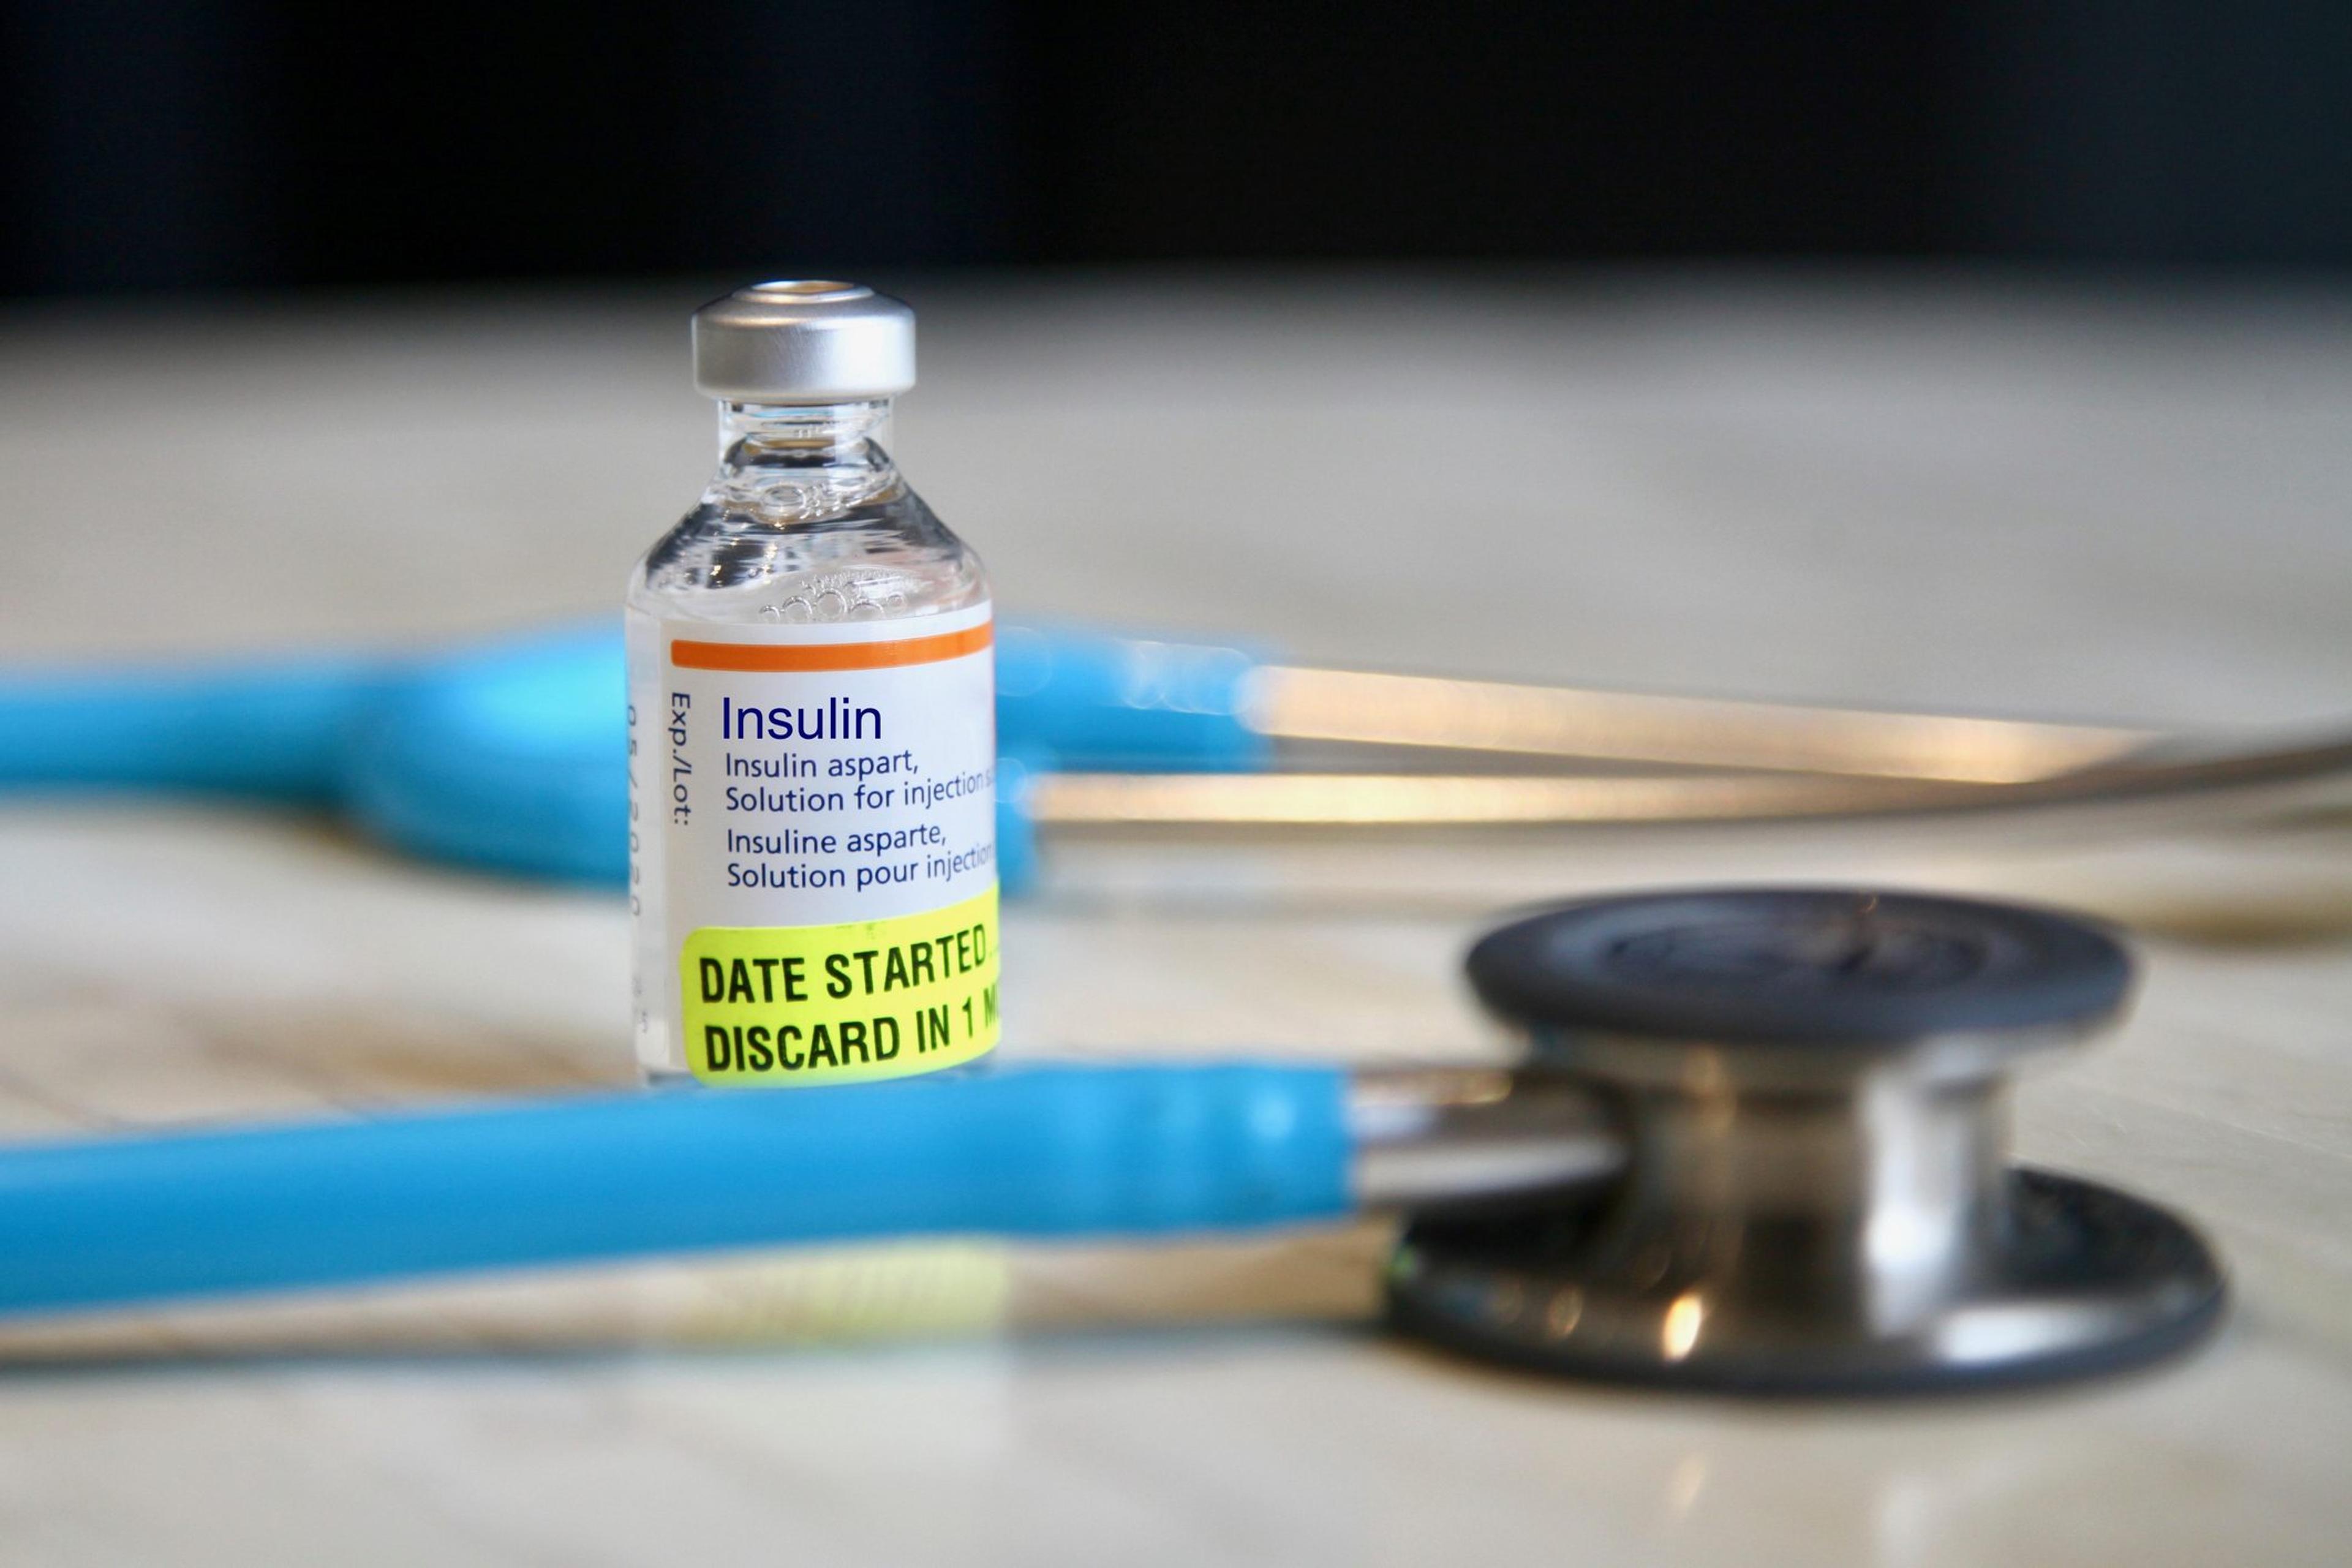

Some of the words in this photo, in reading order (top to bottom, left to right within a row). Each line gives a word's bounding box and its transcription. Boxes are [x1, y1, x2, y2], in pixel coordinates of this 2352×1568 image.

[723, 697, 881, 739] Insulin
[668, 692, 692, 826] Exp./Lot:
[726, 752, 816, 777] Insulin
[828, 750, 918, 781] aspart,
[726, 786, 843, 811] Solution
[854, 784, 894, 809] for
[904, 771, 984, 809] injection
[728, 829, 836, 853] Insuline
[847, 823, 946, 856] asparte,
[728, 863, 845, 888] Solution
[856, 862, 918, 892] pour
[700, 957, 808, 1003] DATE
[705, 1017, 899, 1072] DISCARD
[916, 1004, 950, 1054] IN
[962, 997, 973, 1038] 1
